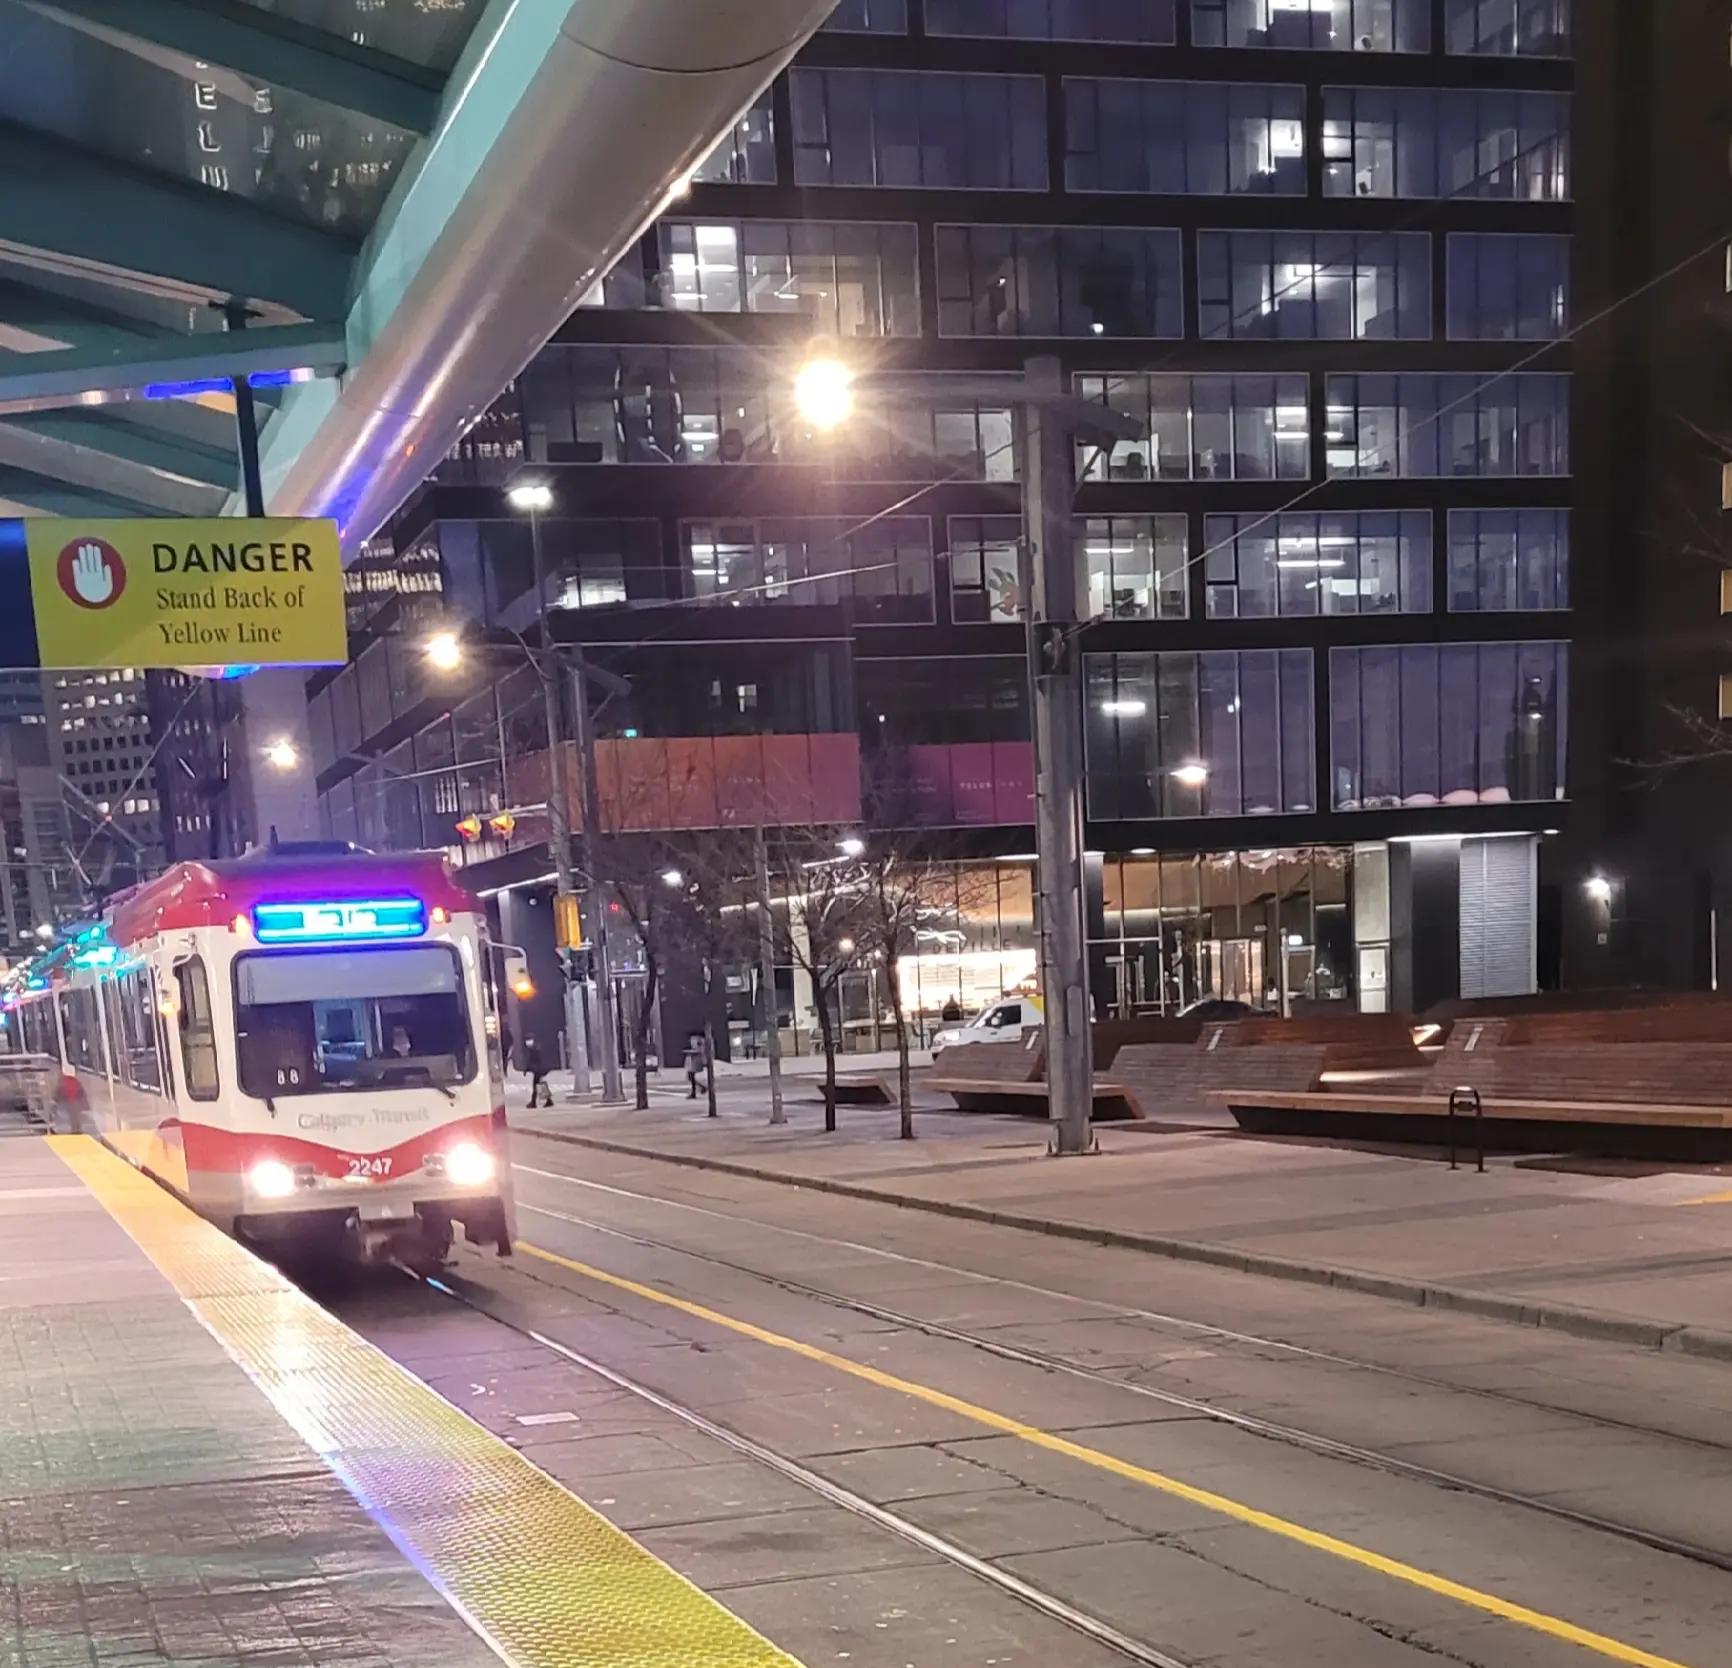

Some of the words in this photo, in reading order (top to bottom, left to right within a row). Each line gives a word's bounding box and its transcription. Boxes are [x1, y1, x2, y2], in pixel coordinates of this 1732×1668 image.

[152, 543, 314, 573] DANGER
[157, 587, 216, 610] Stand
[225, 585, 278, 609] Back
[284, 585, 305, 608] of
[159, 623, 230, 645] Yellow
[239, 622, 282, 644] Line
[349, 1156, 393, 1176] 2247
